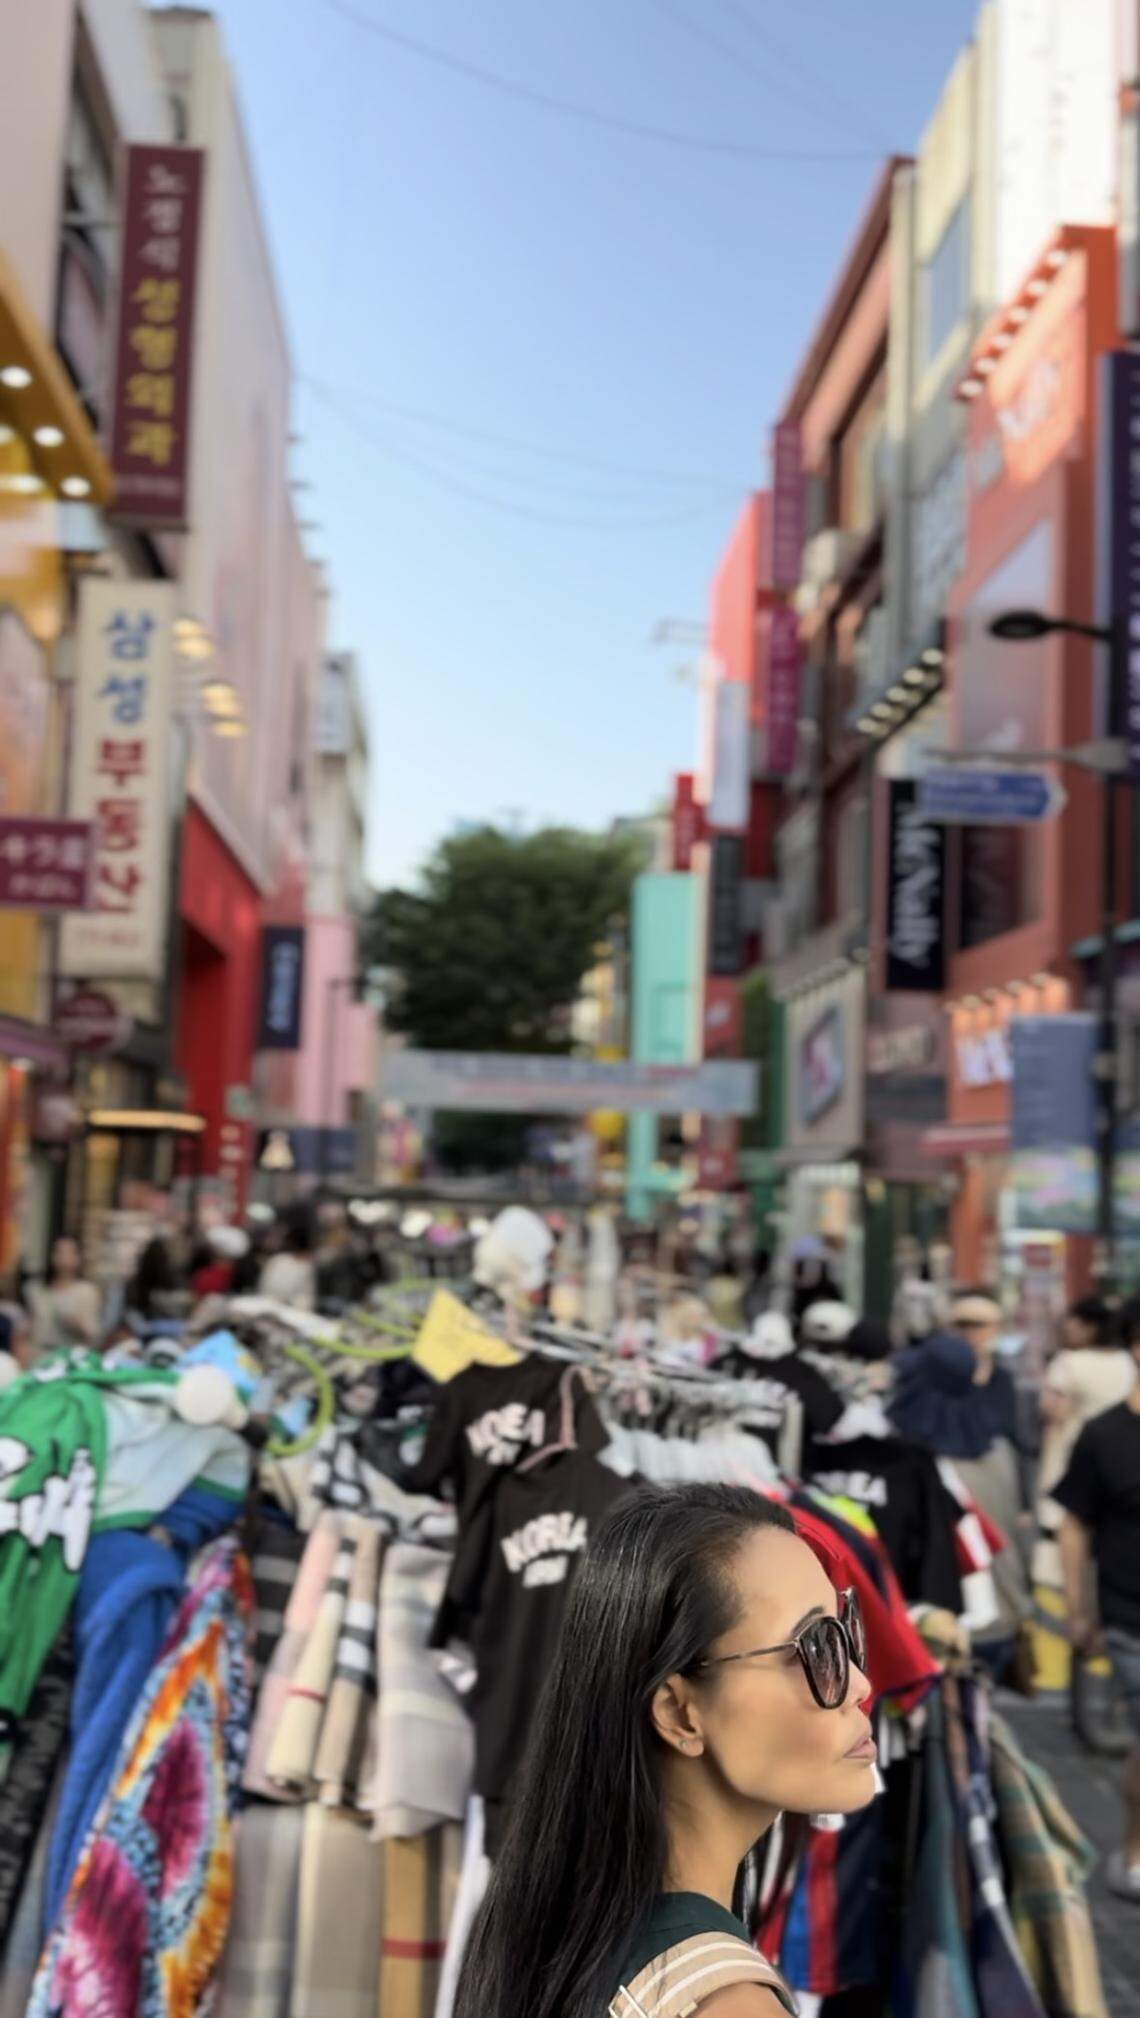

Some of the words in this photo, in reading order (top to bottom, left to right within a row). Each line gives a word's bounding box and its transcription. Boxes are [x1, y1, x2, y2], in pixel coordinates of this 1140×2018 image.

[97, 608, 154, 723] 삼성
[95, 740, 146, 913] 부동산
[500, 1511, 589, 1573] KOREA
